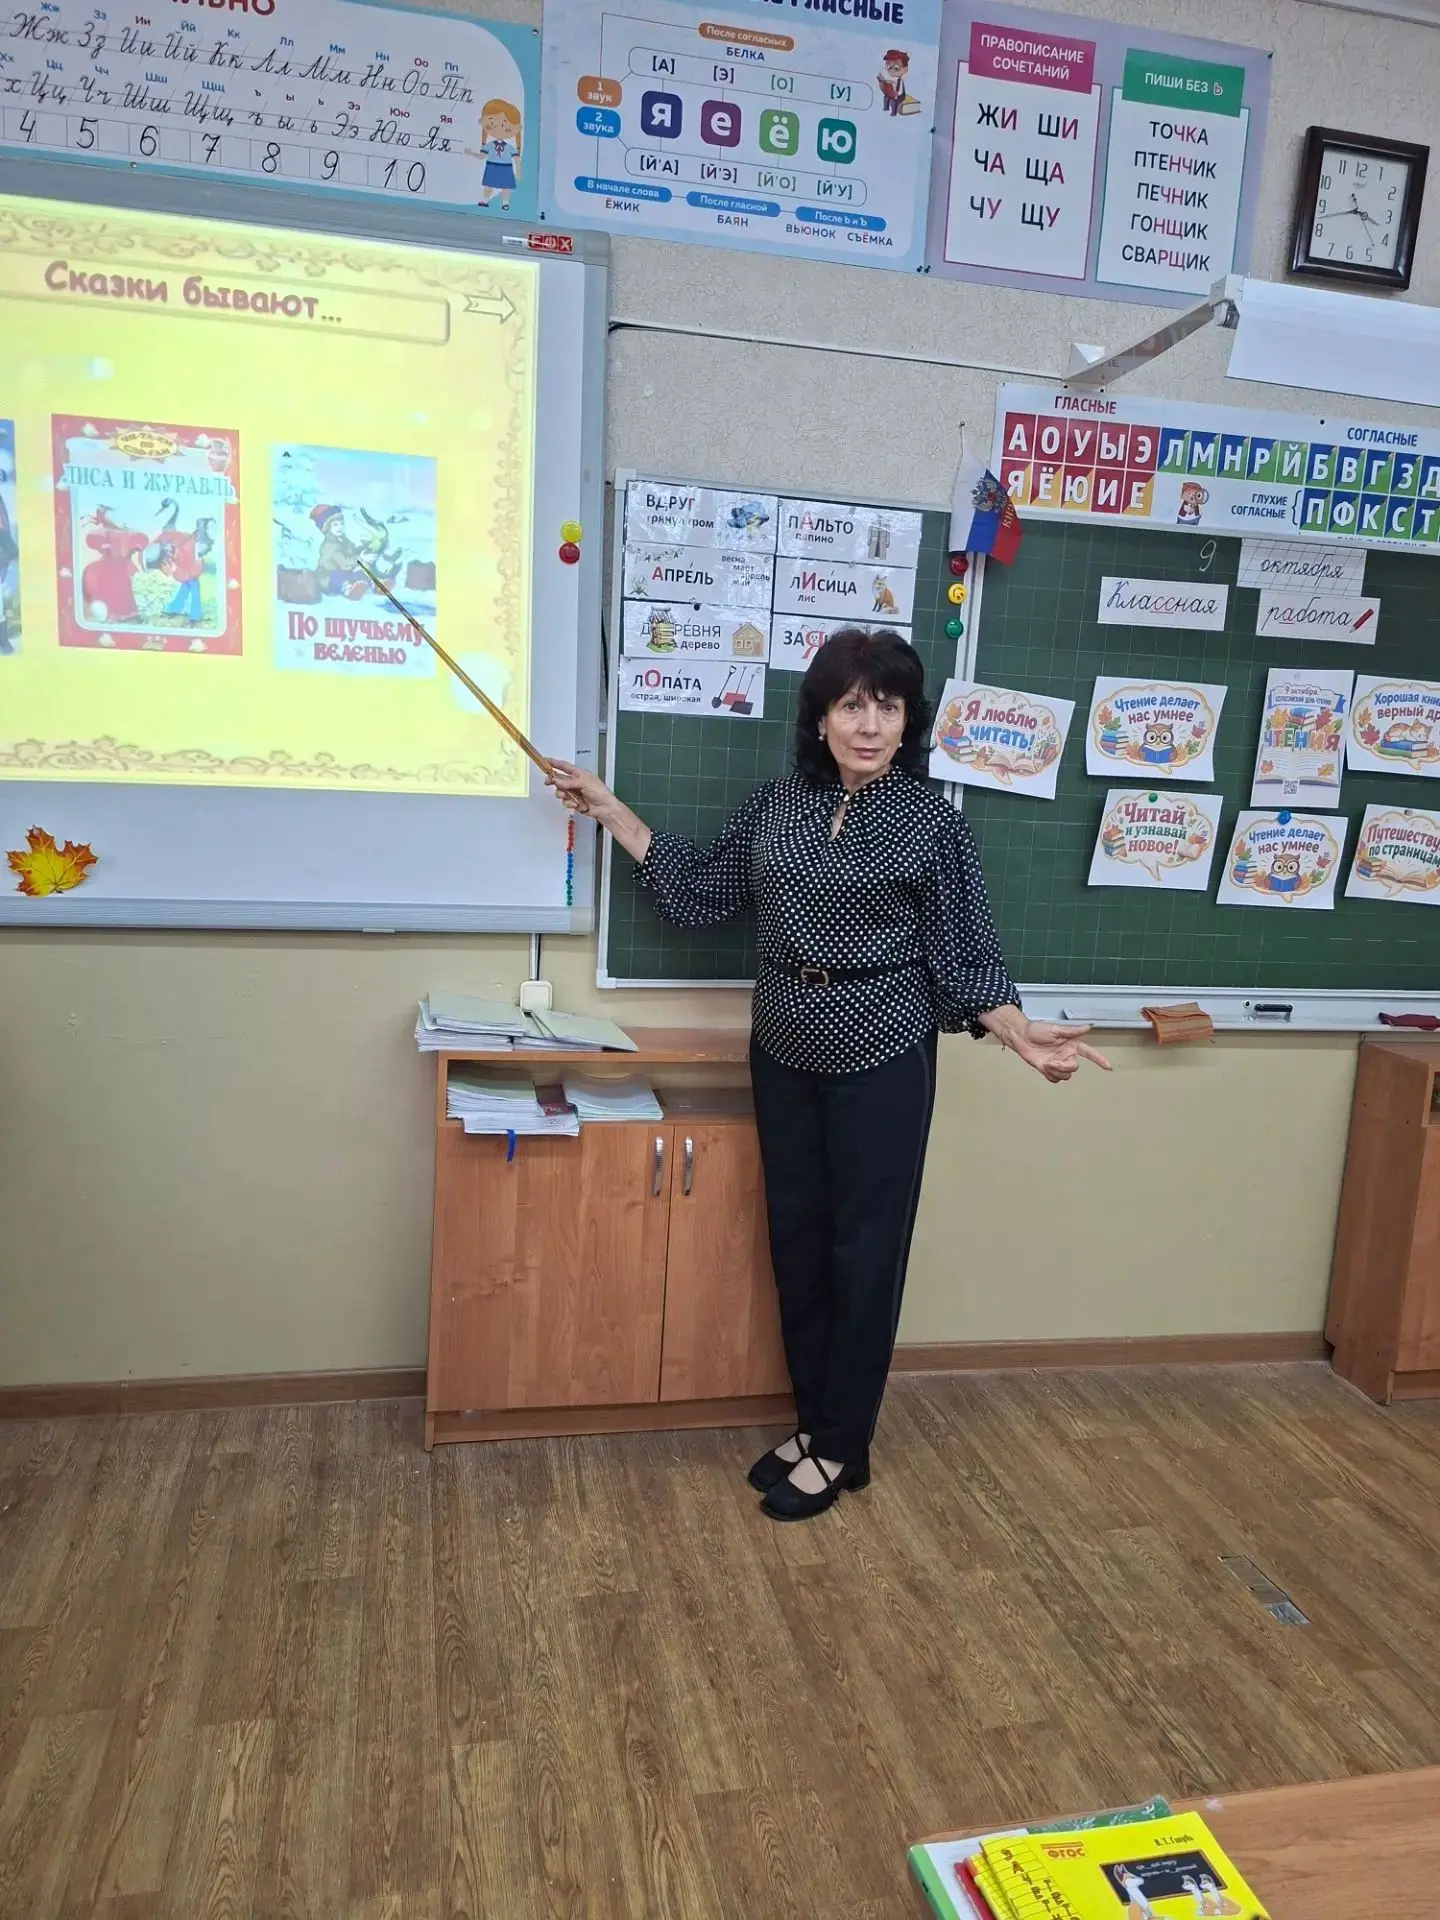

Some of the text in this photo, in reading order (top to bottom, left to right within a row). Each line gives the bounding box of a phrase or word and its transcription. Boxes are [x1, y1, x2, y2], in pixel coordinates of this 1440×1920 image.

[726, 46, 765, 61] БЕЛКА
[980, 34, 1085, 64] ПРАВОПИСАНИЕ
[992, 55, 1070, 81] СОЧЕТАНИЙ
[1145, 72, 1184, 91] ПИШИ
[1185, 78, 1208, 94] БЕЗ
[588, 91, 612, 104] звук
[595, 112, 602, 122] 2
[977, 103, 1079, 140] ЖИ ШИ
[584, 122, 614, 134] звука
[1149, 121, 1208, 145] ТОЧКА
[19, 109, 426, 192] 4 5 6 7 8 9 10
[974, 148, 1065, 185] ЧА ЩА
[1133, 151, 1217, 179] ПТЕНЧИК
[1338, 160, 1368, 178] 11 12
[596, 183, 630, 195] начале
[632, 187, 659, 198] слова
[1136, 182, 1208, 210] ПЕЧНИК
[1320, 174, 1396, 200] 10 2
[605, 199, 640, 212] ЁЖИК
[701, 195, 767, 212] После гласной
[970, 195, 1060, 231] ЧУ ЩУ
[1318, 200, 1392, 224] 9 3
[718, 214, 748, 227] БАЯН
[815, 211, 842, 223] После
[1130, 213, 1208, 242] ГОНЩИК
[786, 224, 836, 239] ВЬЮНОК
[847, 232, 893, 246] СЪЁМКА
[1315, 223, 1389, 247] 8 4
[1121, 244, 1210, 273] СВАРЩИК
[1328, 243, 1373, 262] 7 6 5
[44, 260, 341, 323] Сказки бывают...
[1055, 396, 1117, 414] ГЛАСНЫЕ
[1347, 427, 1418, 447] СОГЛАСНЫЕ
[62, 465, 233, 497] ЛИСА И ЖУРАВЛЬ
[1252, 493, 1288, 506] ГЛУХИЕ
[1231, 505, 1286, 519] СОГЛАСНЫЕ
[789, 512, 854, 534] ПАЛЬТО
[1199, 539, 1217, 572] 9
[1261, 553, 1344, 586] октября
[1107, 580, 1219, 614] Классная
[1260, 596, 1353, 632] работа
[681, 640, 720, 651] дерево
[783, 629, 828, 659] ЗАЯ
[1115, 696, 1200, 711] Чтение делает
[1374, 693, 1440, 706] Хорошая кни
[965, 700, 1037, 730] Я люблю
[1128, 708, 1193, 724] нас умнее
[1377, 705, 1424, 720] верный
[969, 724, 1035, 750] читать!
[1264, 729, 1341, 751] ЧТЕНИЯ
[1124, 802, 1187, 825] Читай
[1134, 824, 1187, 841] узнавай
[1249, 828, 1326, 843] Чтение делает
[1367, 824, 1440, 853] Путешеству
[1128, 838, 1179, 855] новое!
[1258, 841, 1320, 855] нас умнее
[1369, 845, 1380, 857] по
[1048, 1848, 1086, 1858] ФГОС
